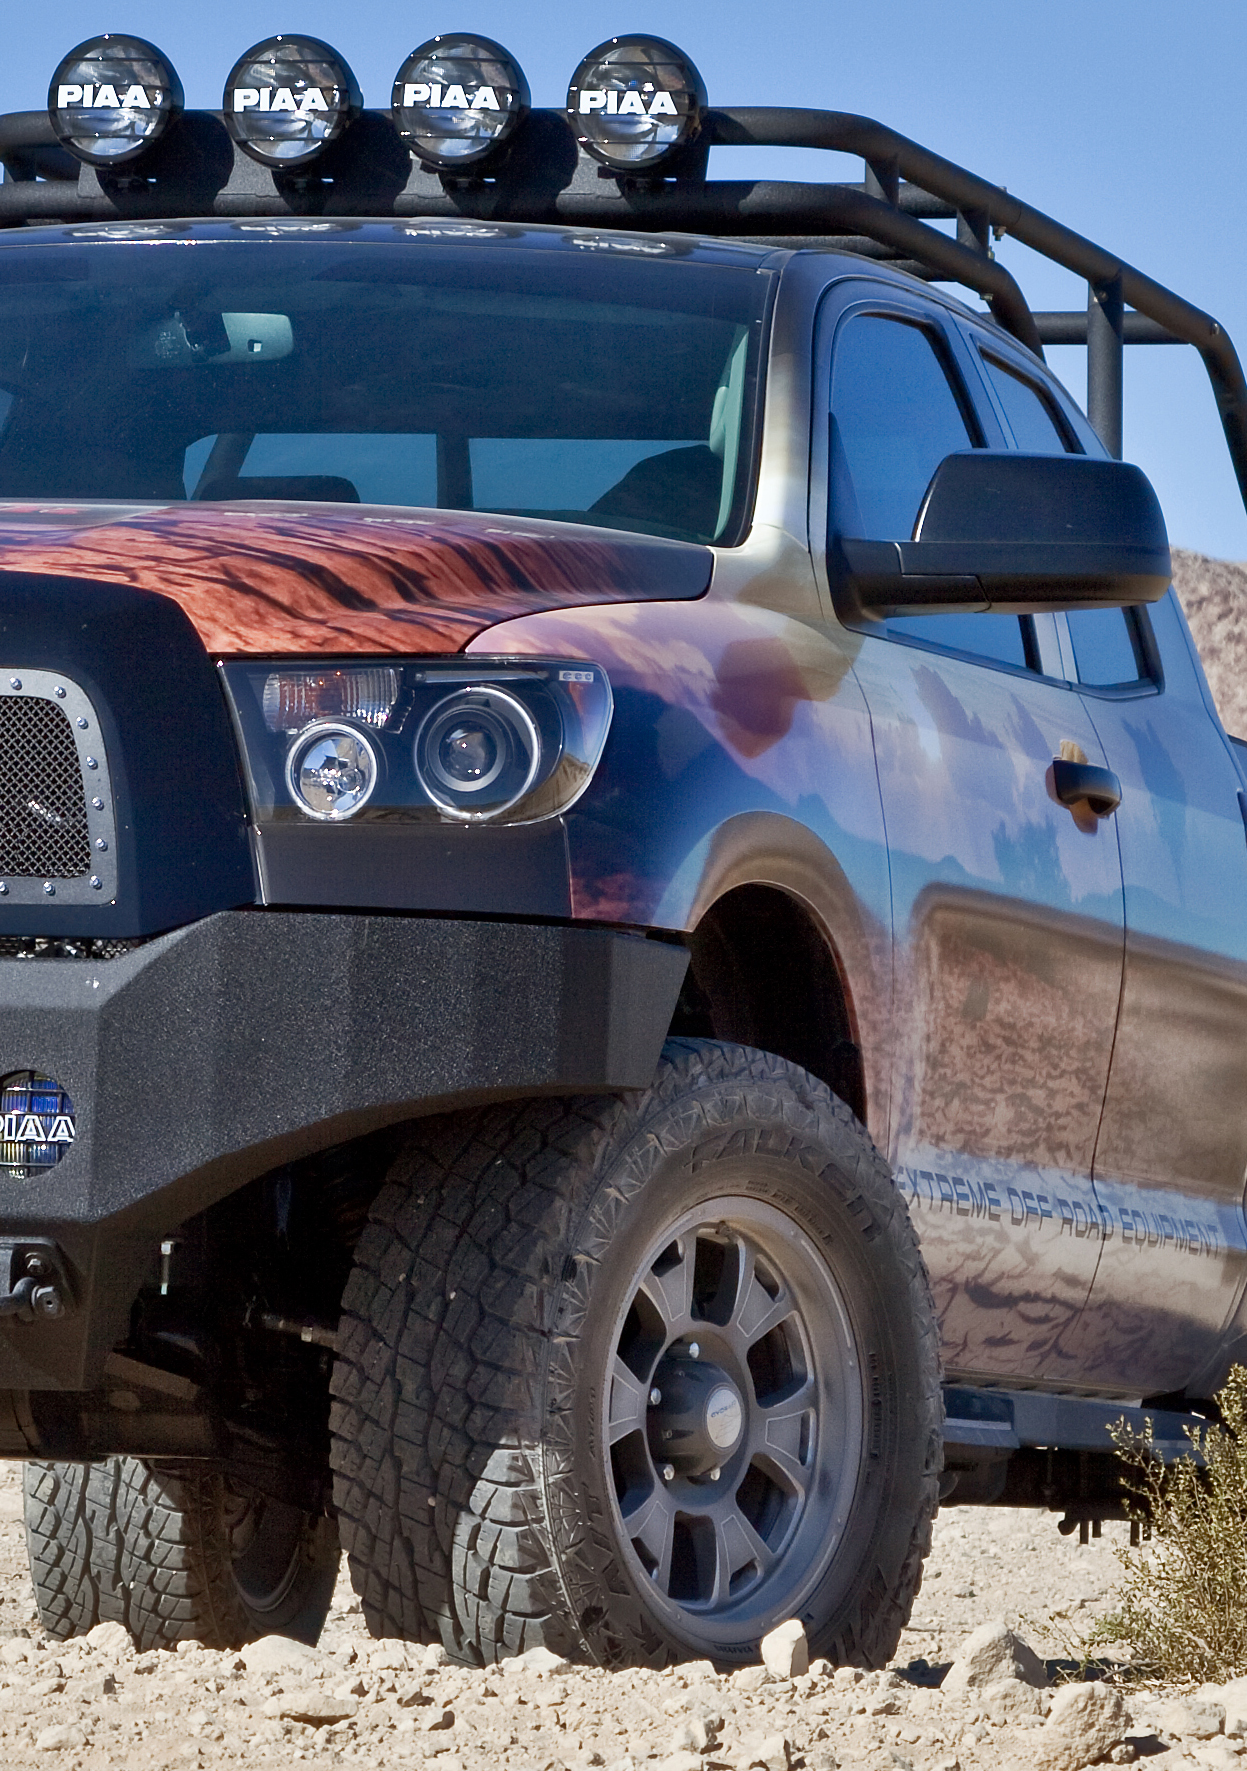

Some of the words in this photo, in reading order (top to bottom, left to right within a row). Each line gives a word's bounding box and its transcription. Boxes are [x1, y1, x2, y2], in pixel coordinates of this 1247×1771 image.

[57, 84, 151, 110] PIAA
[233, 87, 329, 112] PIAA
[404, 83, 501, 111] PIAA
[579, 90, 678, 115] PIAA
[1007, 1186, 1053, 1231] OFF
[1056, 1198, 1114, 1242] ROAD
[1118, 1207, 1219, 1260] EQUIPMENT
